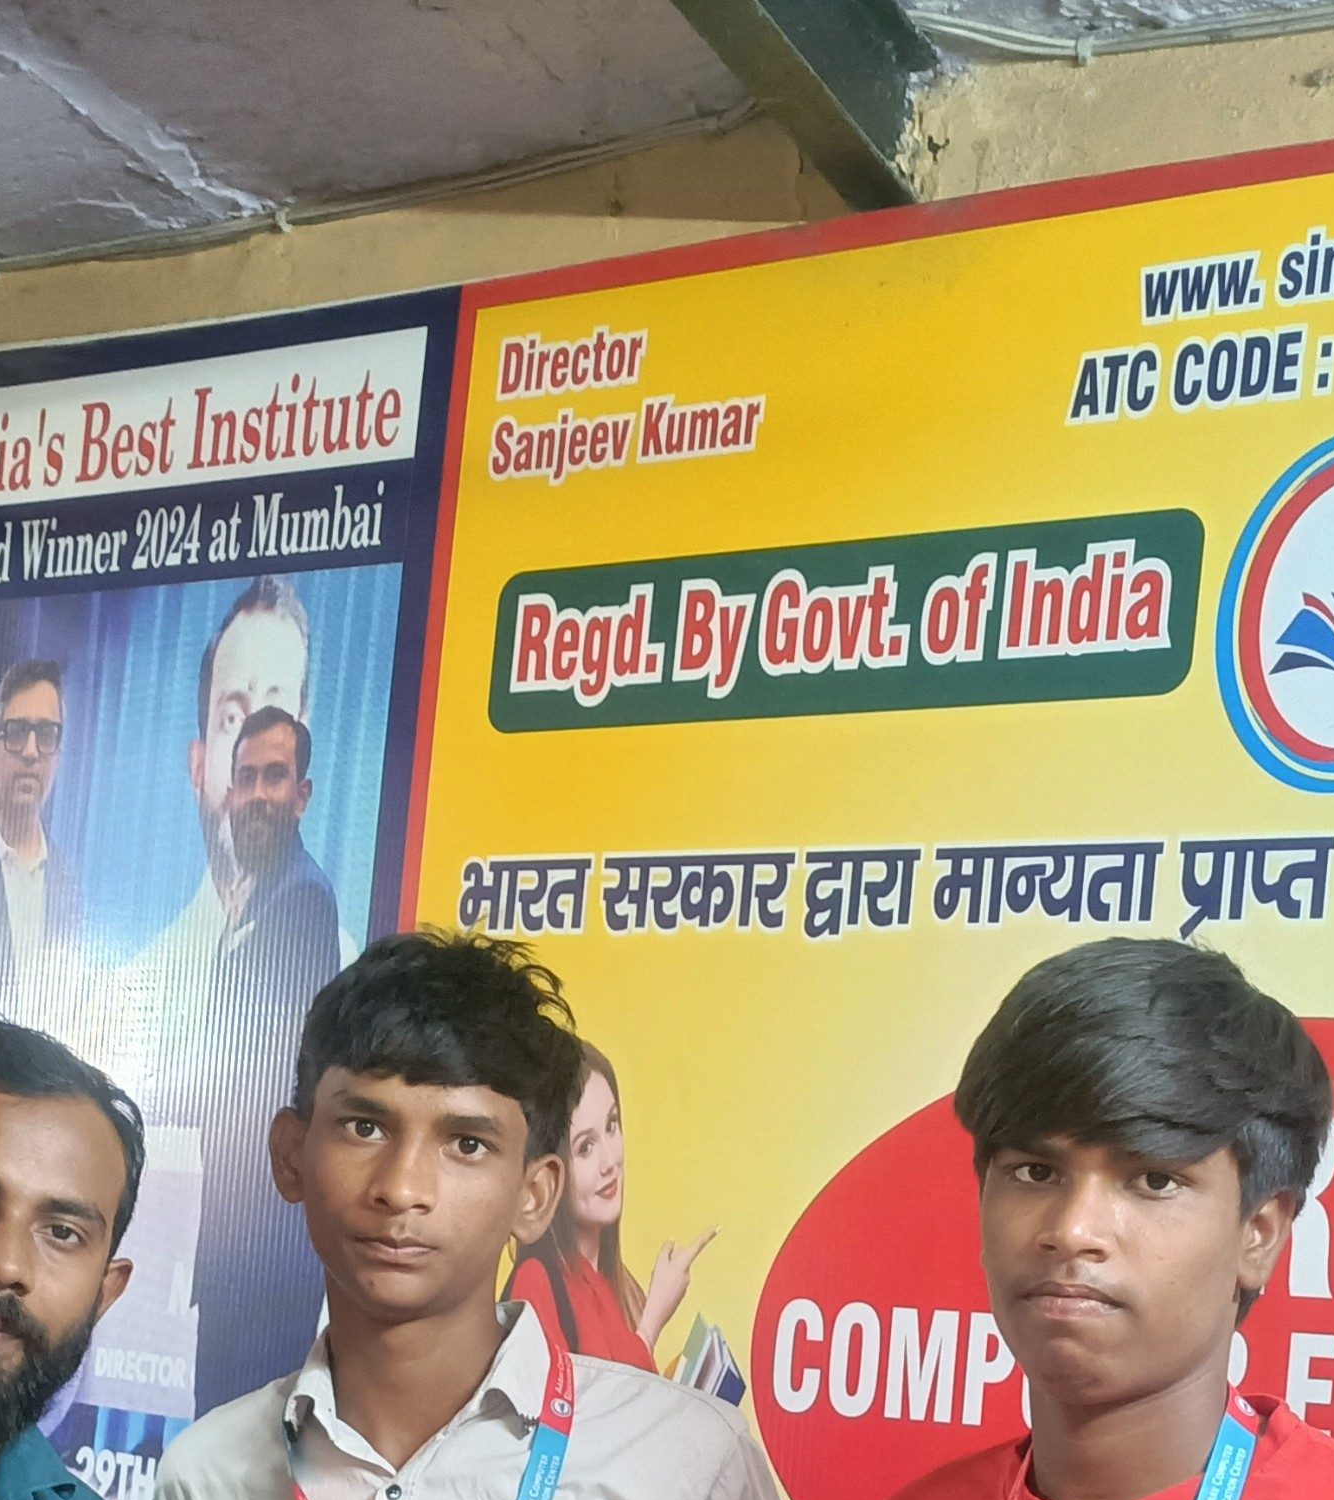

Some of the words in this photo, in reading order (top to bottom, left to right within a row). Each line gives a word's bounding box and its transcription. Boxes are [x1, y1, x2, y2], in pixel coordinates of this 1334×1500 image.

[1144, 259, 1261, 318] www.
[501, 333, 644, 394] Director
[1070, 351, 1156, 419] ATC
[1173, 331, 1301, 405] CODE
[1319, 342, 1332, 389] :
[75, 395, 175, 482] Best
[188, 370, 402, 470] Institute
[492, 416, 630, 479] Sanjeev
[641, 399, 761, 456] Kumar
[22, 516, 128, 581] Winner
[131, 504, 201, 570] 2024
[209, 517, 241, 560] at
[247, 481, 386, 559] Mumbai
[516, 596, 658, 696] Regd.
[681, 588, 748, 686] By
[767, 577, 903, 662] Govt.
[927, 563, 989, 655] of
[1005, 552, 1163, 649] India
[459, 858, 591, 930] भारत
[603, 852, 792, 927] सरकार
[804, 849, 919, 935] द्वारा
[934, 842, 1161, 922] मान्यता
[95, 1347, 186, 1388] DIRECTOR
[529, 1454, 548, 1496] COMPUTER
[545, 1455, 561, 1486] CENTER
